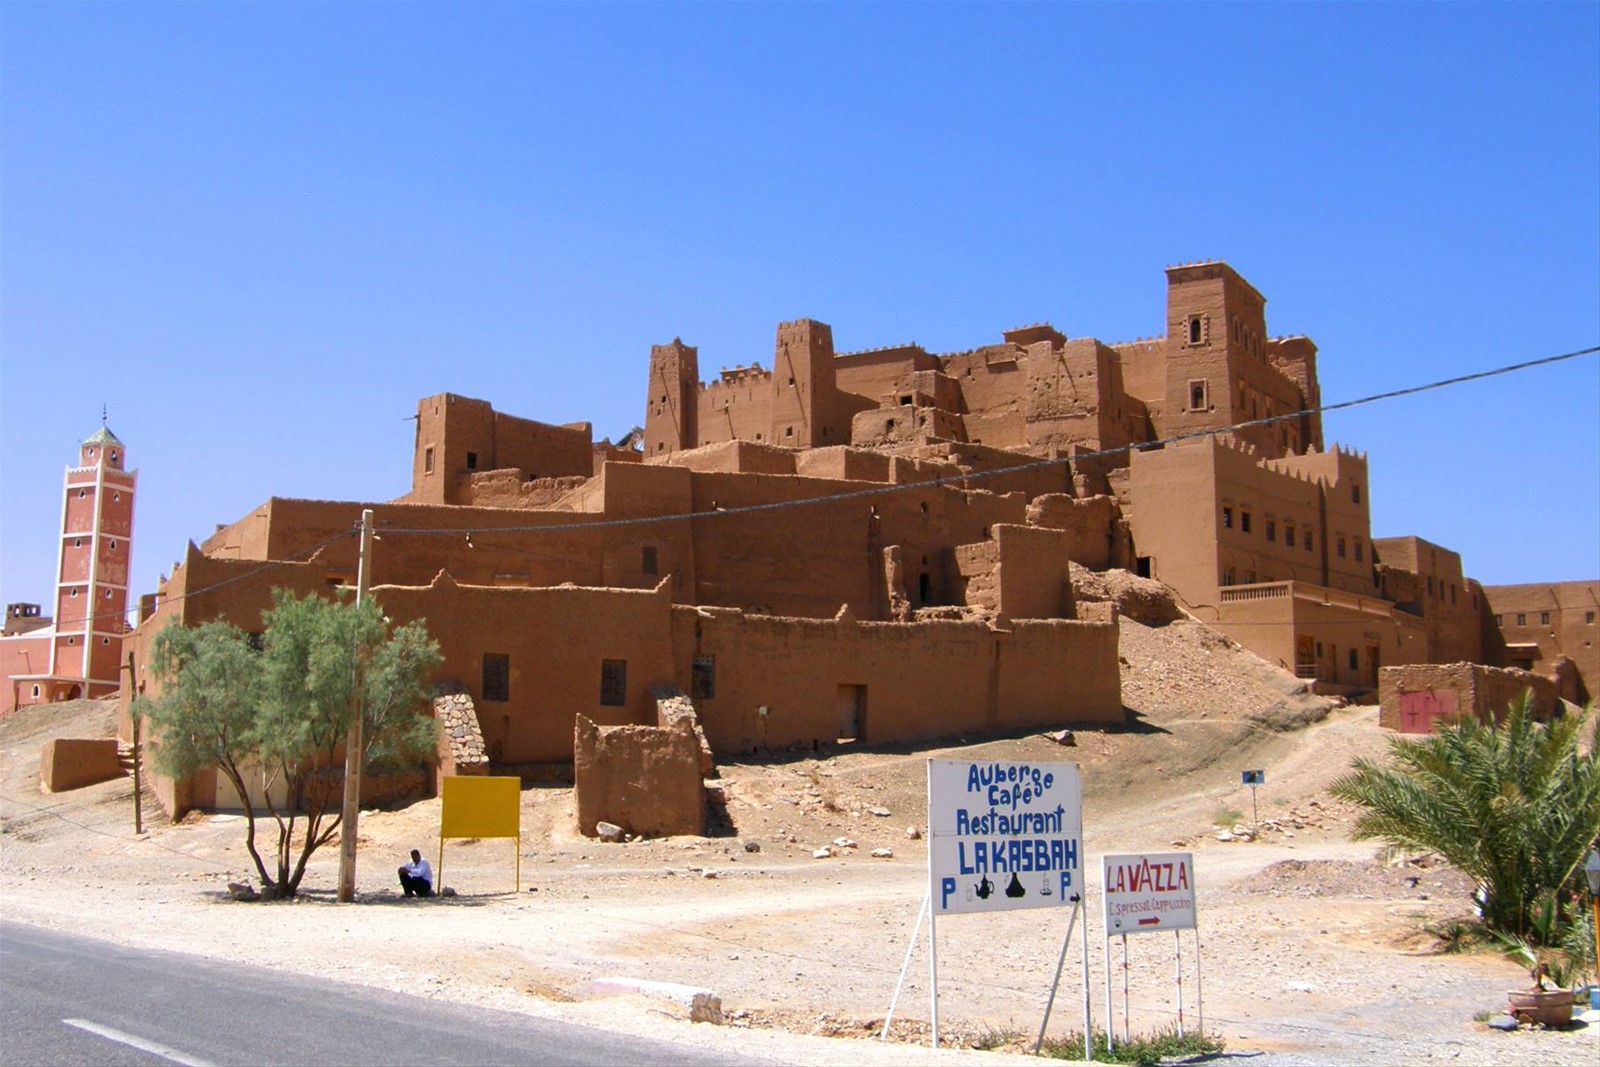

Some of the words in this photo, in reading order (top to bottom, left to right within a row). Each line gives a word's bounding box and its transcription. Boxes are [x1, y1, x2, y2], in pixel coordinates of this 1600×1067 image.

[967, 763, 1054, 798] Auberge
[987, 782, 1033, 811] Café
[956, 803, 1066, 836] Restaurant
[941, 877, 957, 910] P
[1060, 871, 1071, 901] P
[1106, 858, 1189, 893] LAVAZZA
